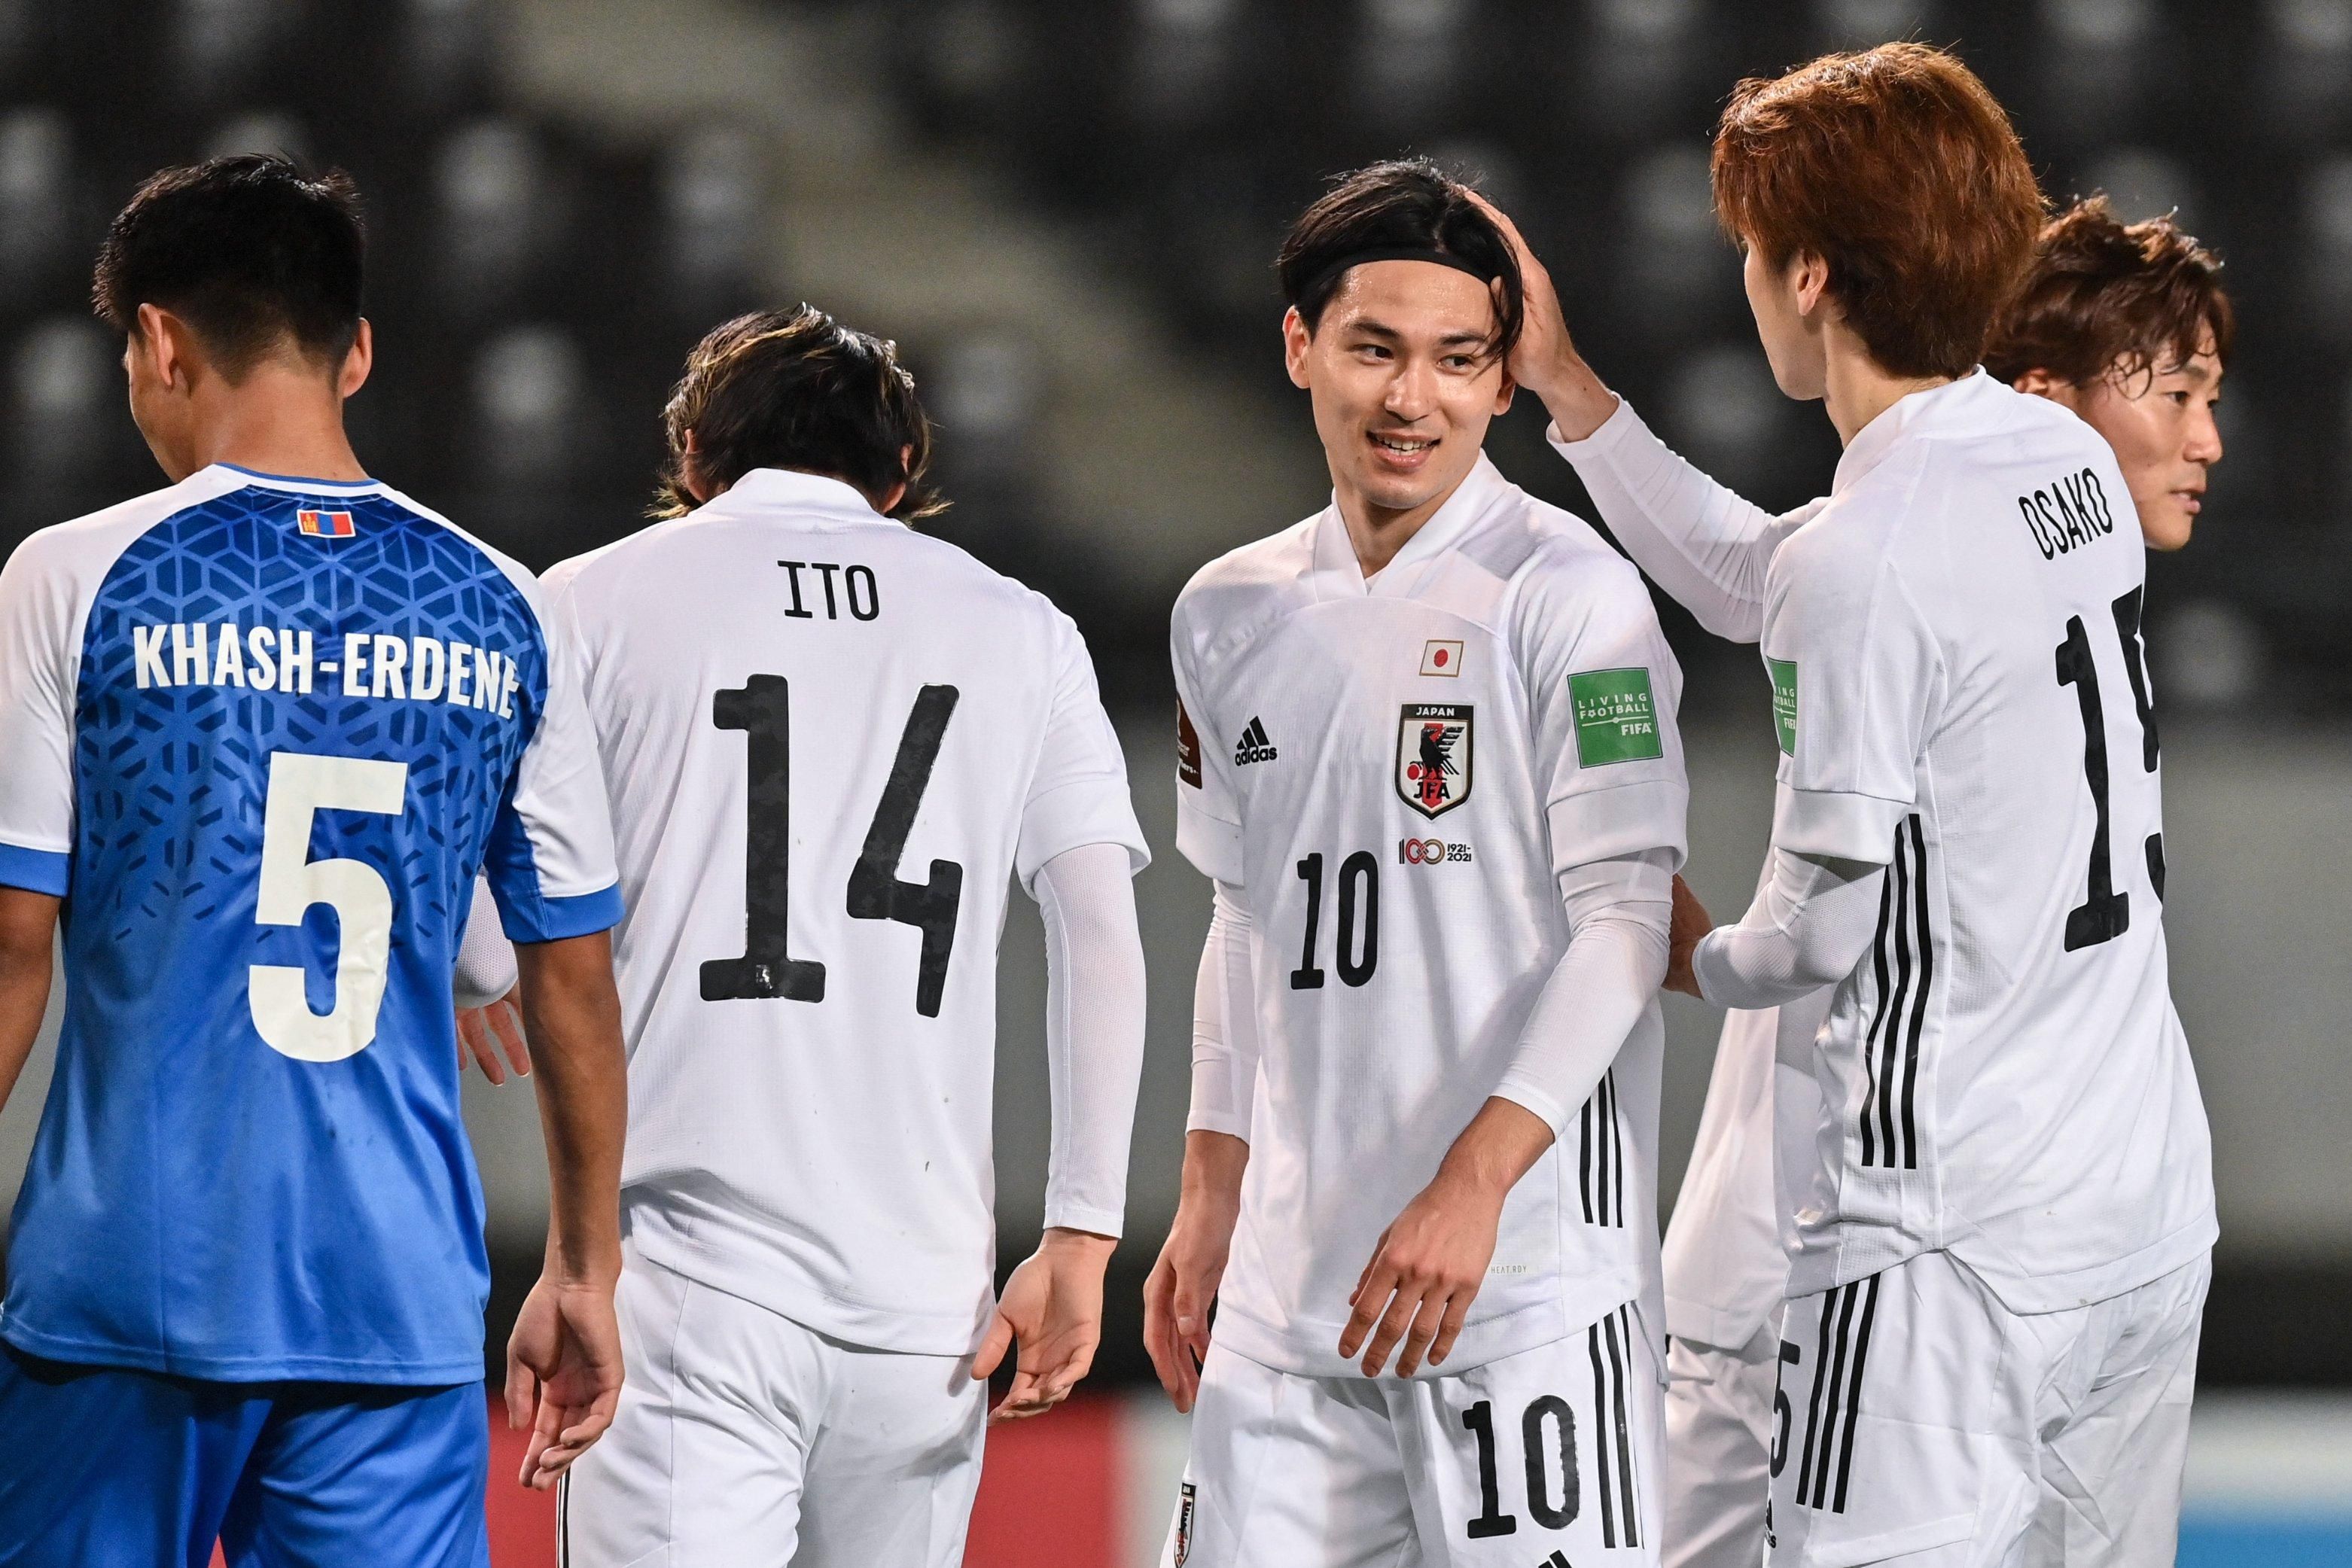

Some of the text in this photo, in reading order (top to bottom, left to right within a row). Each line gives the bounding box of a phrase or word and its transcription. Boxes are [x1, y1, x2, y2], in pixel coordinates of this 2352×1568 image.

[2018, 467, 2113, 560] OSAKO
[778, 561, 880, 621] ITO
[133, 623, 521, 719] KHASH-ERDENE
[1578, 693, 1647, 708] LIVING
[1775, 687, 1794, 698] ING
[1415, 706, 1455, 717] JAPAN
[1580, 703, 1649, 720] FOOTBALL
[1621, 723, 1652, 735] FIFA
[1235, 746, 1278, 766] adidas
[1413, 781, 1450, 799] JFA
[699, 674, 963, 1018] 14
[1447, 843, 1471, 853] 1921-
[1447, 853, 1471, 862] 2021
[248, 751, 408, 1063] 5
[1290, 850, 1379, 991] 10
[1462, 1395, 1580, 1539] 10
